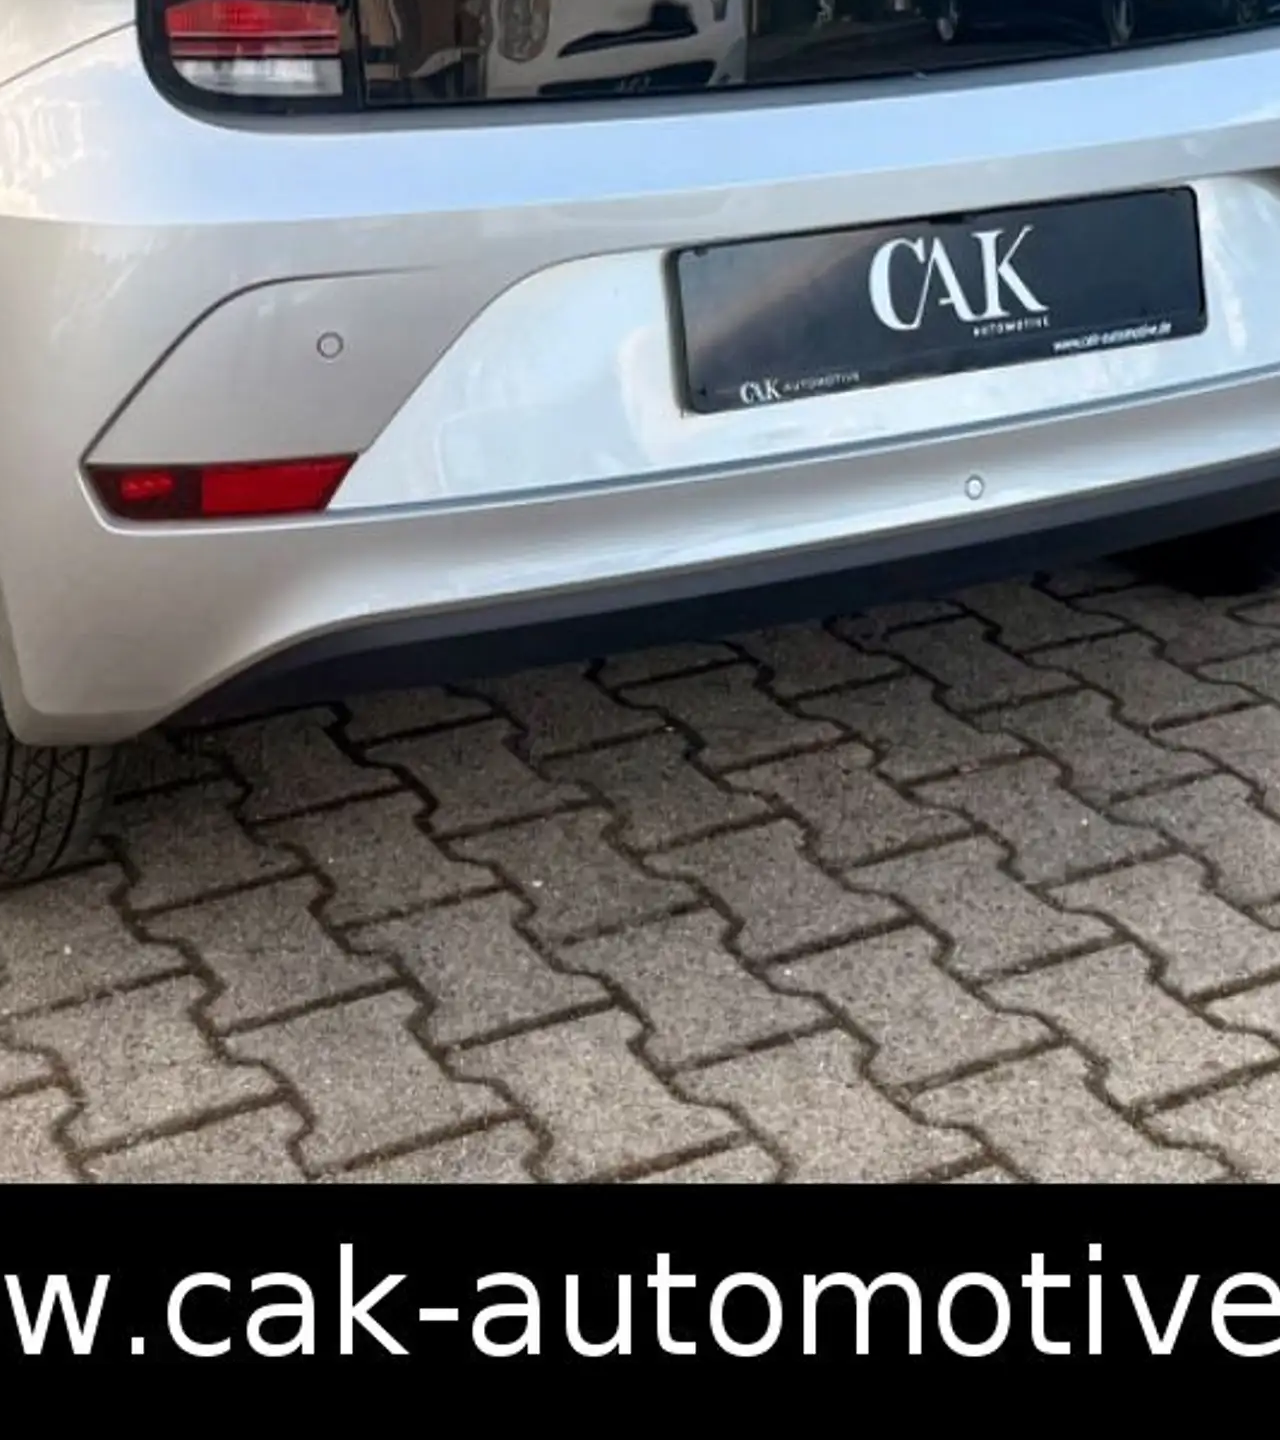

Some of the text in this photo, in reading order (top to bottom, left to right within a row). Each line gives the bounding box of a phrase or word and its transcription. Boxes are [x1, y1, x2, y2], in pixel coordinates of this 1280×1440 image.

[868, 224, 1049, 332] CAK
[1052, 321, 1172, 353] www.ca-auotive.de
[738, 375, 782, 405] CAK
